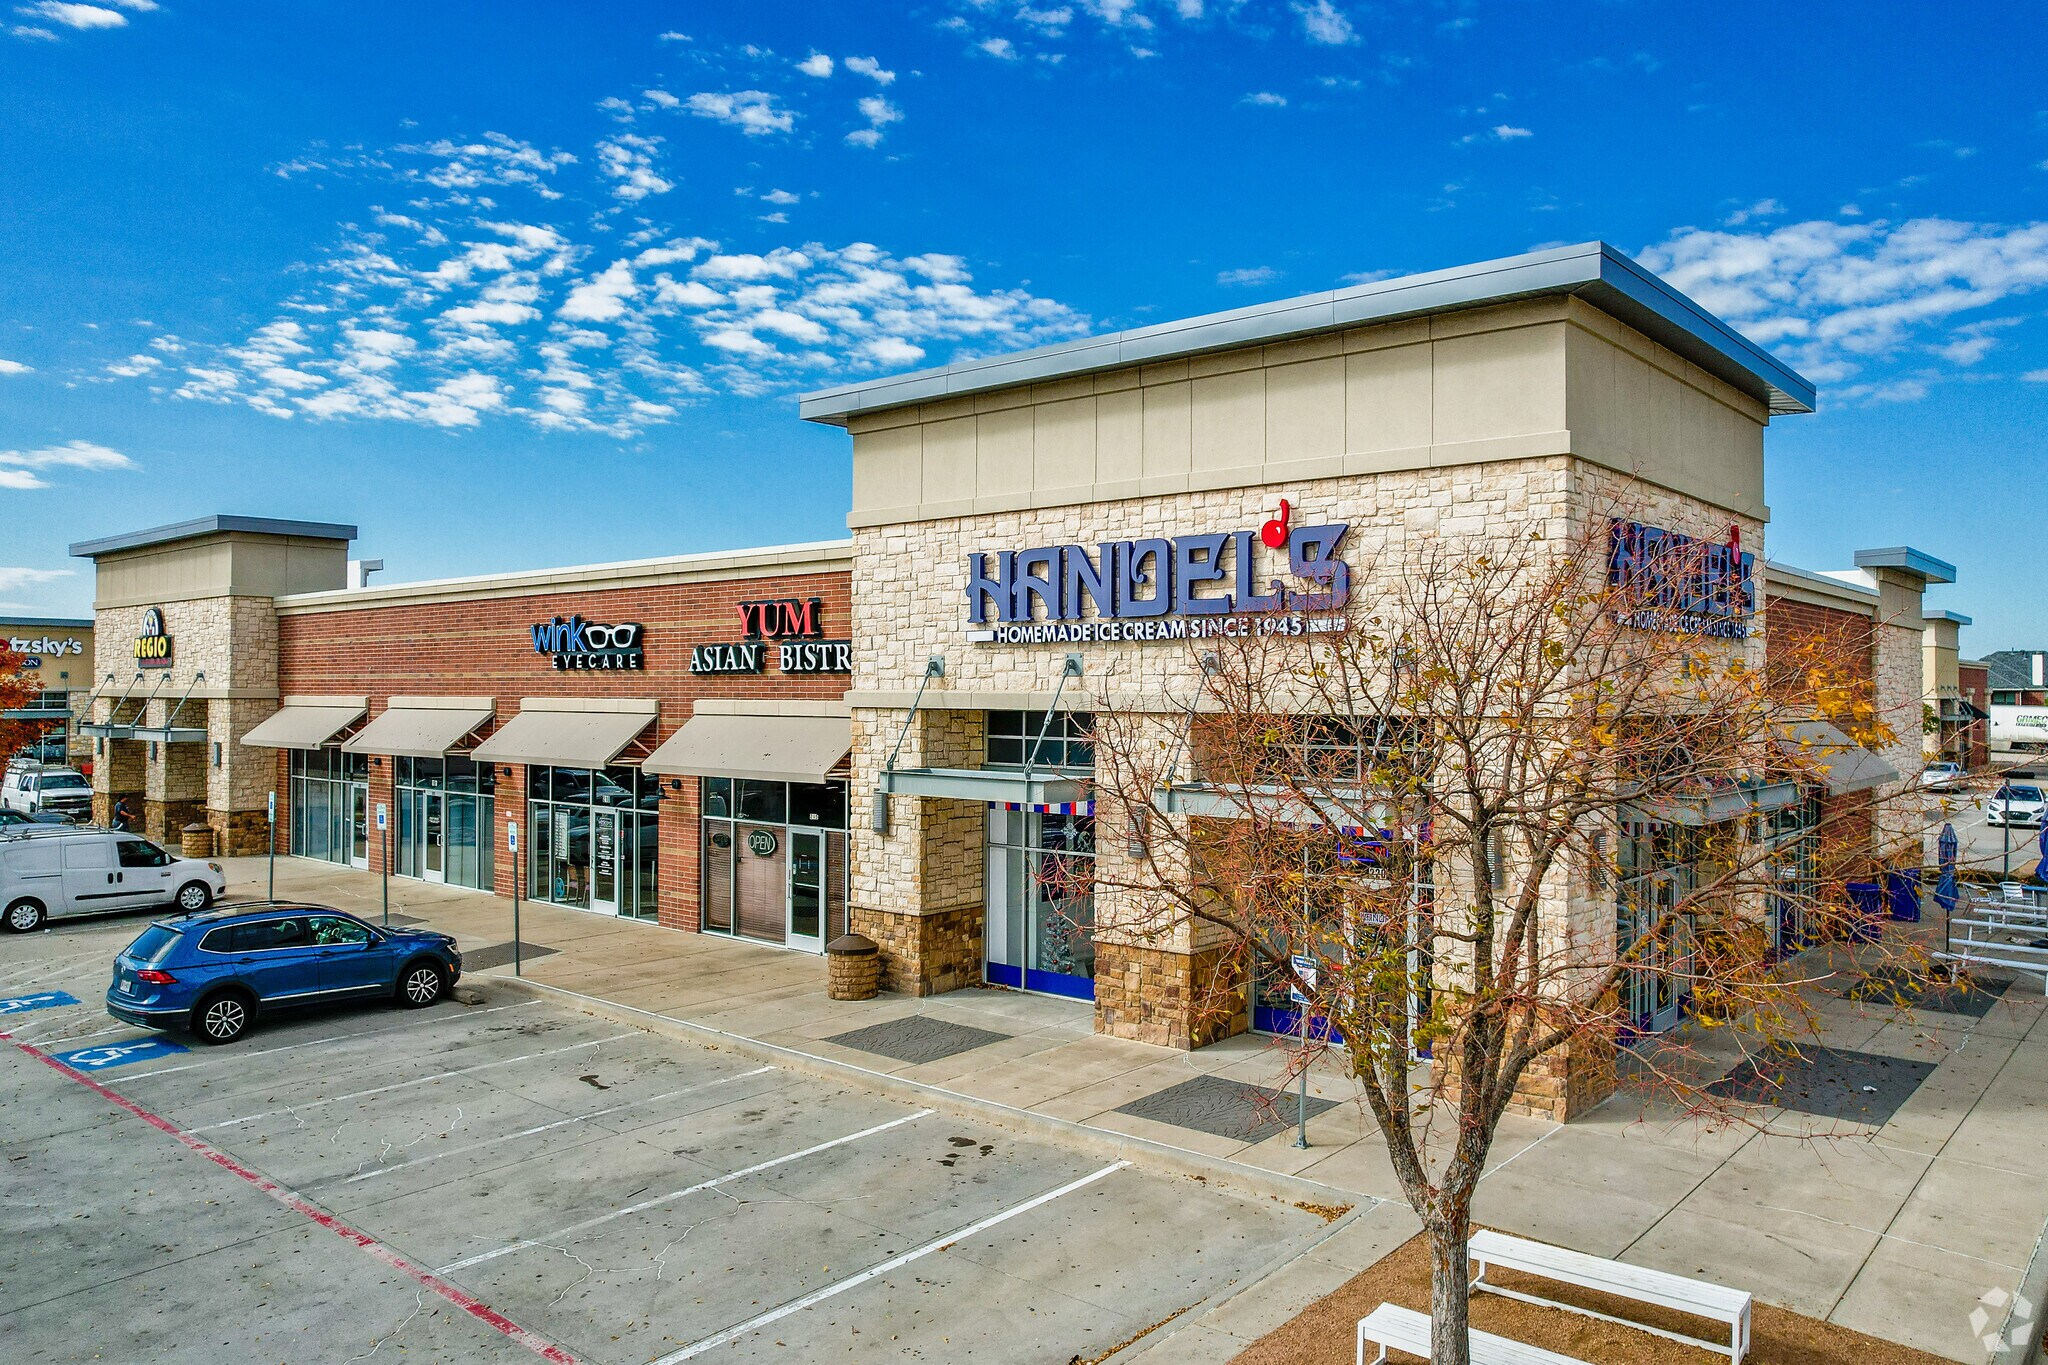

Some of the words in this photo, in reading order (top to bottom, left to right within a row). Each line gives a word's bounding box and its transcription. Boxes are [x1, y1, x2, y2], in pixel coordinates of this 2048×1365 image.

[966, 499, 1349, 623] HANDEL'S
[735, 601, 816, 637] YUM
[998, 622, 1091, 643] HOMEMADE
[1095, 622, 1119, 641] ICE
[1123, 619, 1186, 640] CREAM
[1190, 617, 1249, 638] SINCE
[1255, 617, 1301, 637] 1945
[133, 636, 167, 658] REGIO
[530, 616, 588, 653] wink
[552, 653, 637, 668] EYECARE
[688, 644, 757, 672] ASIAN
[749, 834, 771, 851] OPEN
